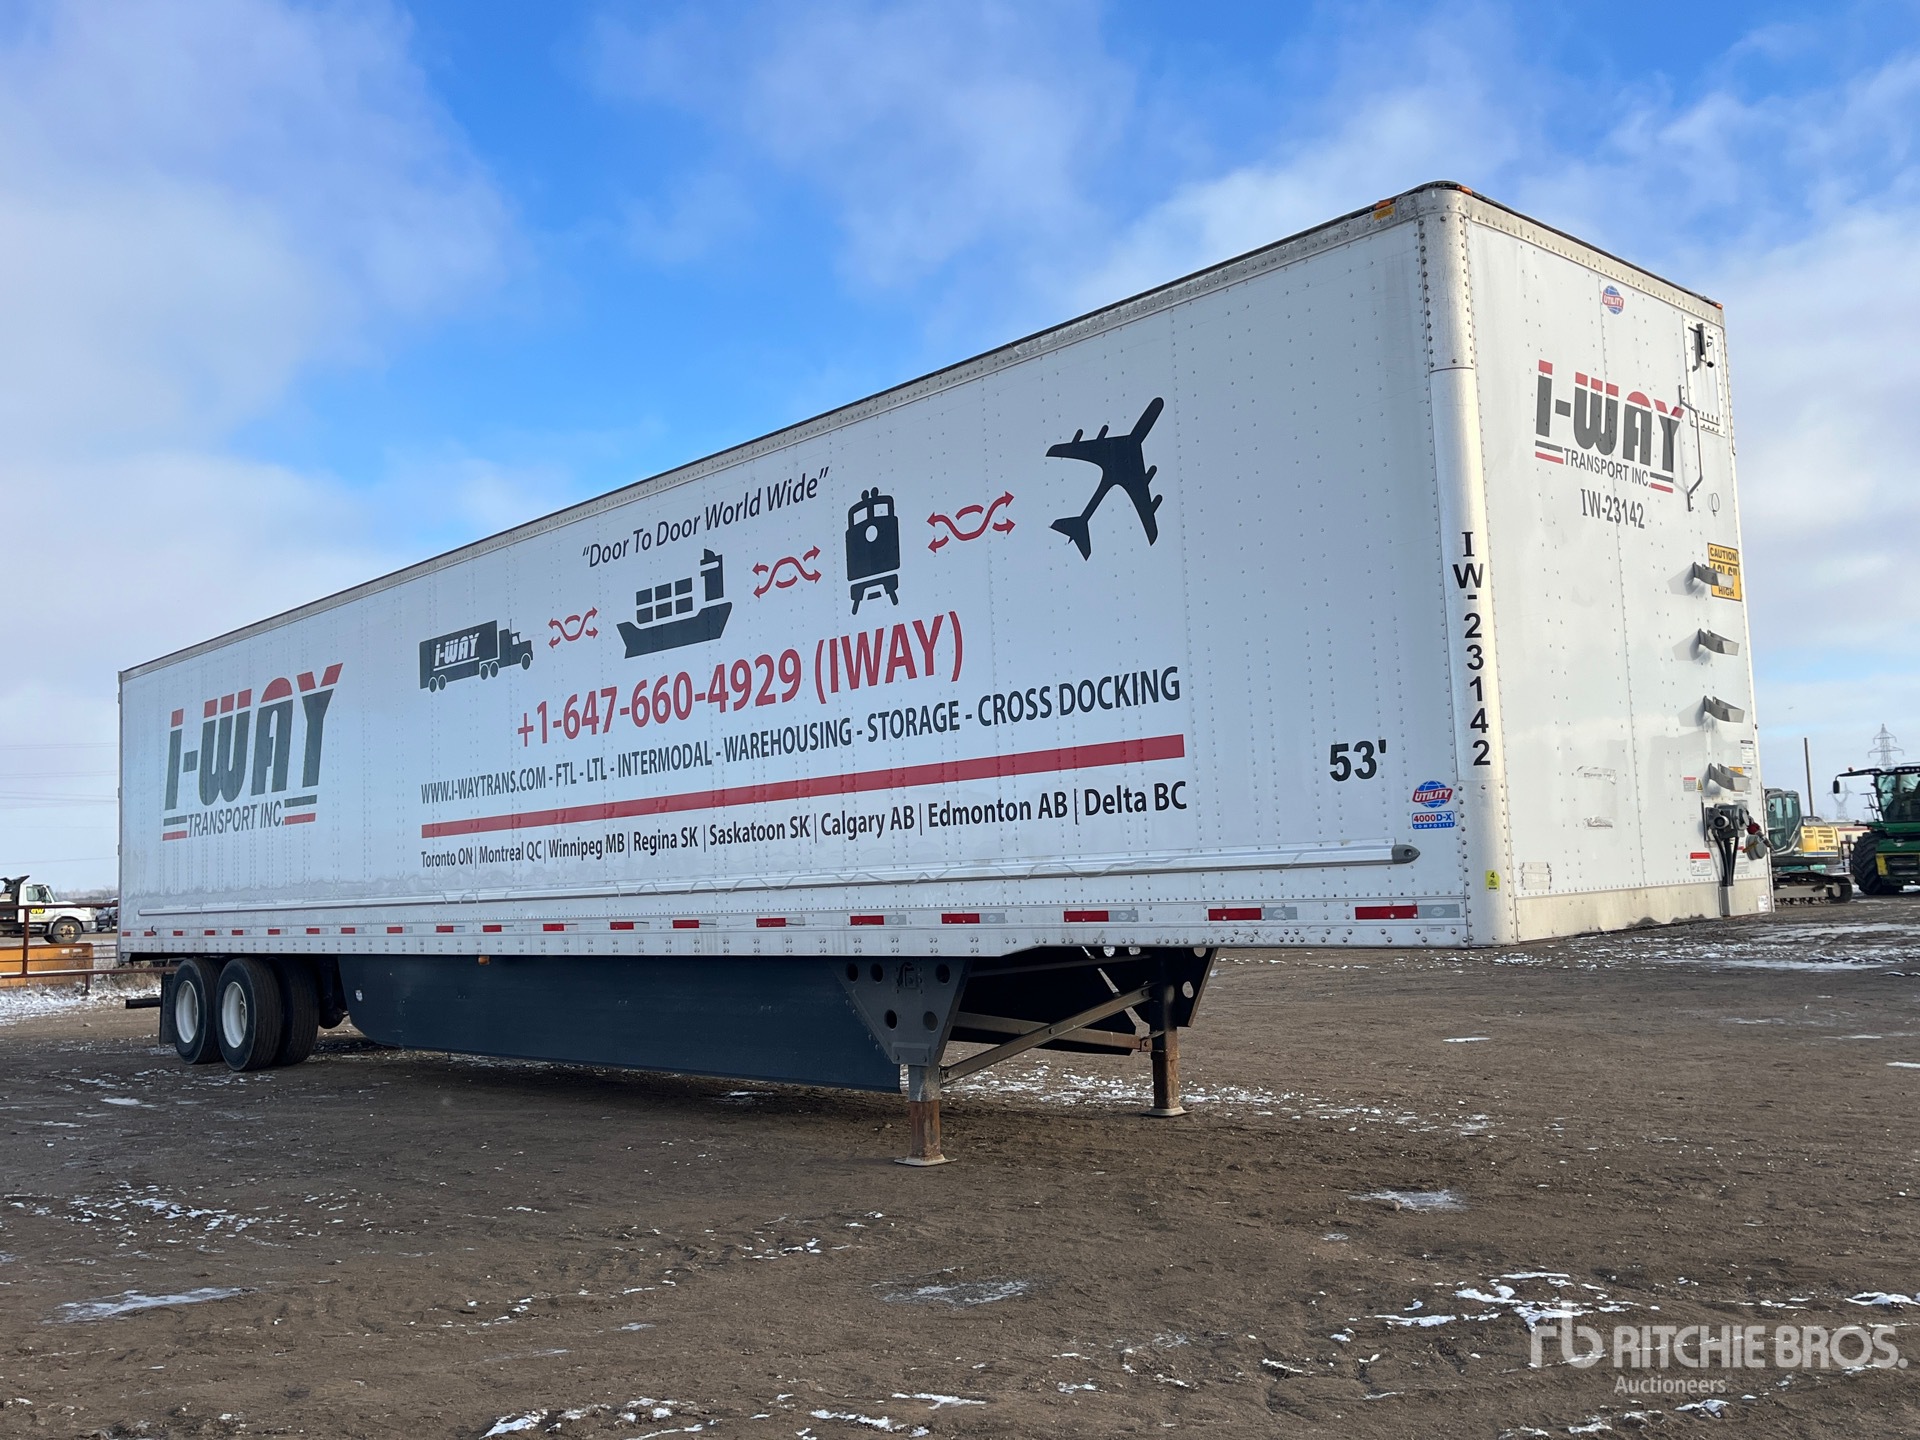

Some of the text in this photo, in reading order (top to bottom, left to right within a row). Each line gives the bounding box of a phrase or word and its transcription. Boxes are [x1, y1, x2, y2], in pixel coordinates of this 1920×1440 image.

[1564, 447, 1652, 488] TRANSPORT INC.
[634, 527, 652, 554] To
[656, 514, 701, 547] Door
[705, 486, 761, 531] World
[1580, 488, 1646, 529] IW-23142
[1709, 547, 1738, 562] CAUTION
[1718, 586, 1735, 597] HIGH
[517, 611, 963, 747] +1-647-660-4929 (IWAY)
[421, 766, 547, 804] WWW.I-WAYTRANS.COM
[555, 762, 577, 787] FTL
[587, 757, 607, 783] LTL
[617, 740, 713, 778] INTERMODAL
[724, 717, 852, 765] WAREHOUSING
[867, 699, 960, 743] STORAGE
[977, 686, 1052, 727] CROSS
[1058, 666, 1181, 717] DOCKING
[1329, 739, 1387, 782] 53'
[1414, 789, 1452, 802] UTILITY
[186, 801, 285, 838] TRANSPORT INC.
[421, 849, 457, 868] Toronto
[458, 847, 473, 865] ON
[479, 841, 524, 864] Montreal
[526, 840, 542, 861] QC
[549, 835, 603, 861] Winnipeg
[605, 832, 625, 854] MB
[633, 830, 678, 855] Regina
[681, 826, 699, 848] SK
[709, 817, 786, 846] Saskatoon
[789, 813, 811, 839] SK
[821, 807, 886, 841] Calgary
[890, 805, 915, 831] AB
[928, 798, 1032, 828] Edmonton
[1037, 791, 1068, 820] AB
[1084, 784, 1148, 817] Delta
[1154, 781, 1188, 812] BC
[1413, 813, 1453, 823] 4000D-X
